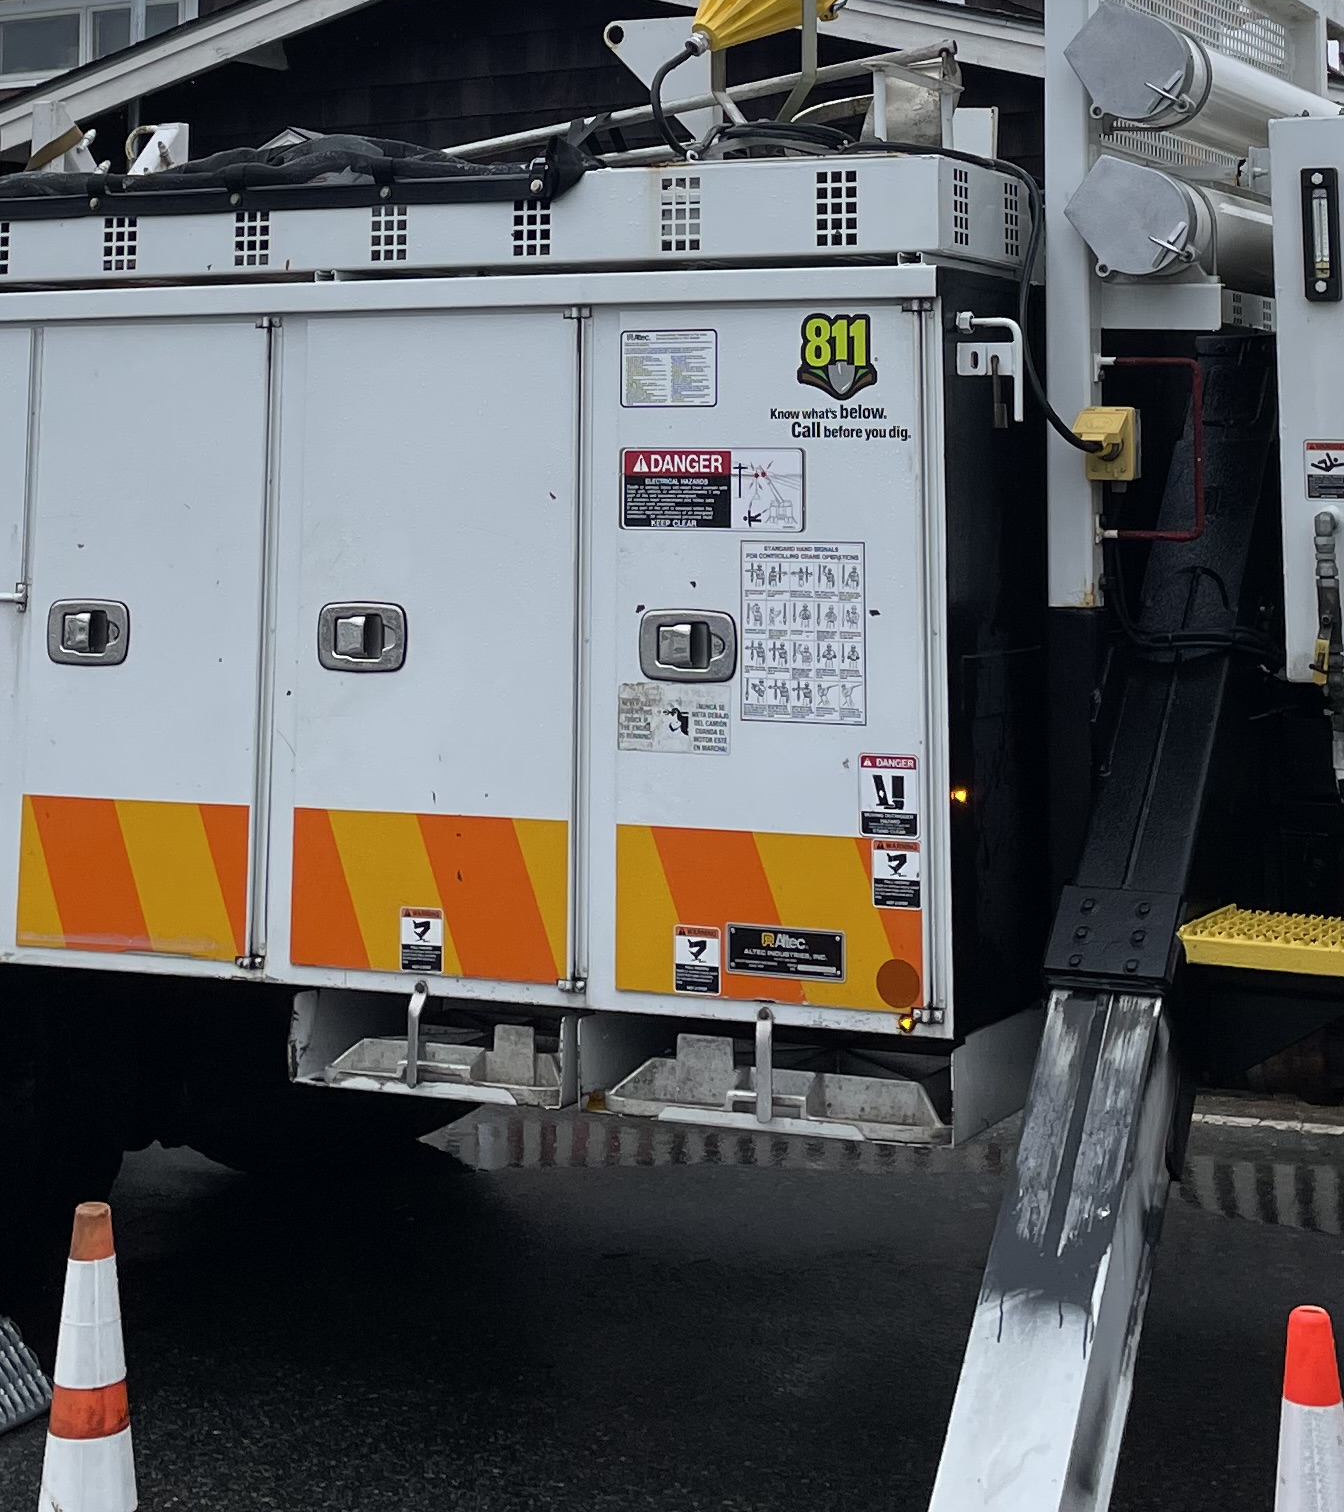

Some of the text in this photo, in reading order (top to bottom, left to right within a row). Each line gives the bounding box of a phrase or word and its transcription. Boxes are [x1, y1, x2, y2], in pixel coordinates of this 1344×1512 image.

[805, 317, 867, 368] 811
[769, 404, 887, 420] Know what's below.
[791, 421, 912, 442] Call before you dig.
[650, 454, 723, 473] DANGER
[650, 519, 697, 527] KEEP CLEAR
[876, 758, 914, 768] DANGER
[774, 933, 807, 949] Altec
[743, 948, 767, 956] ALTEC
